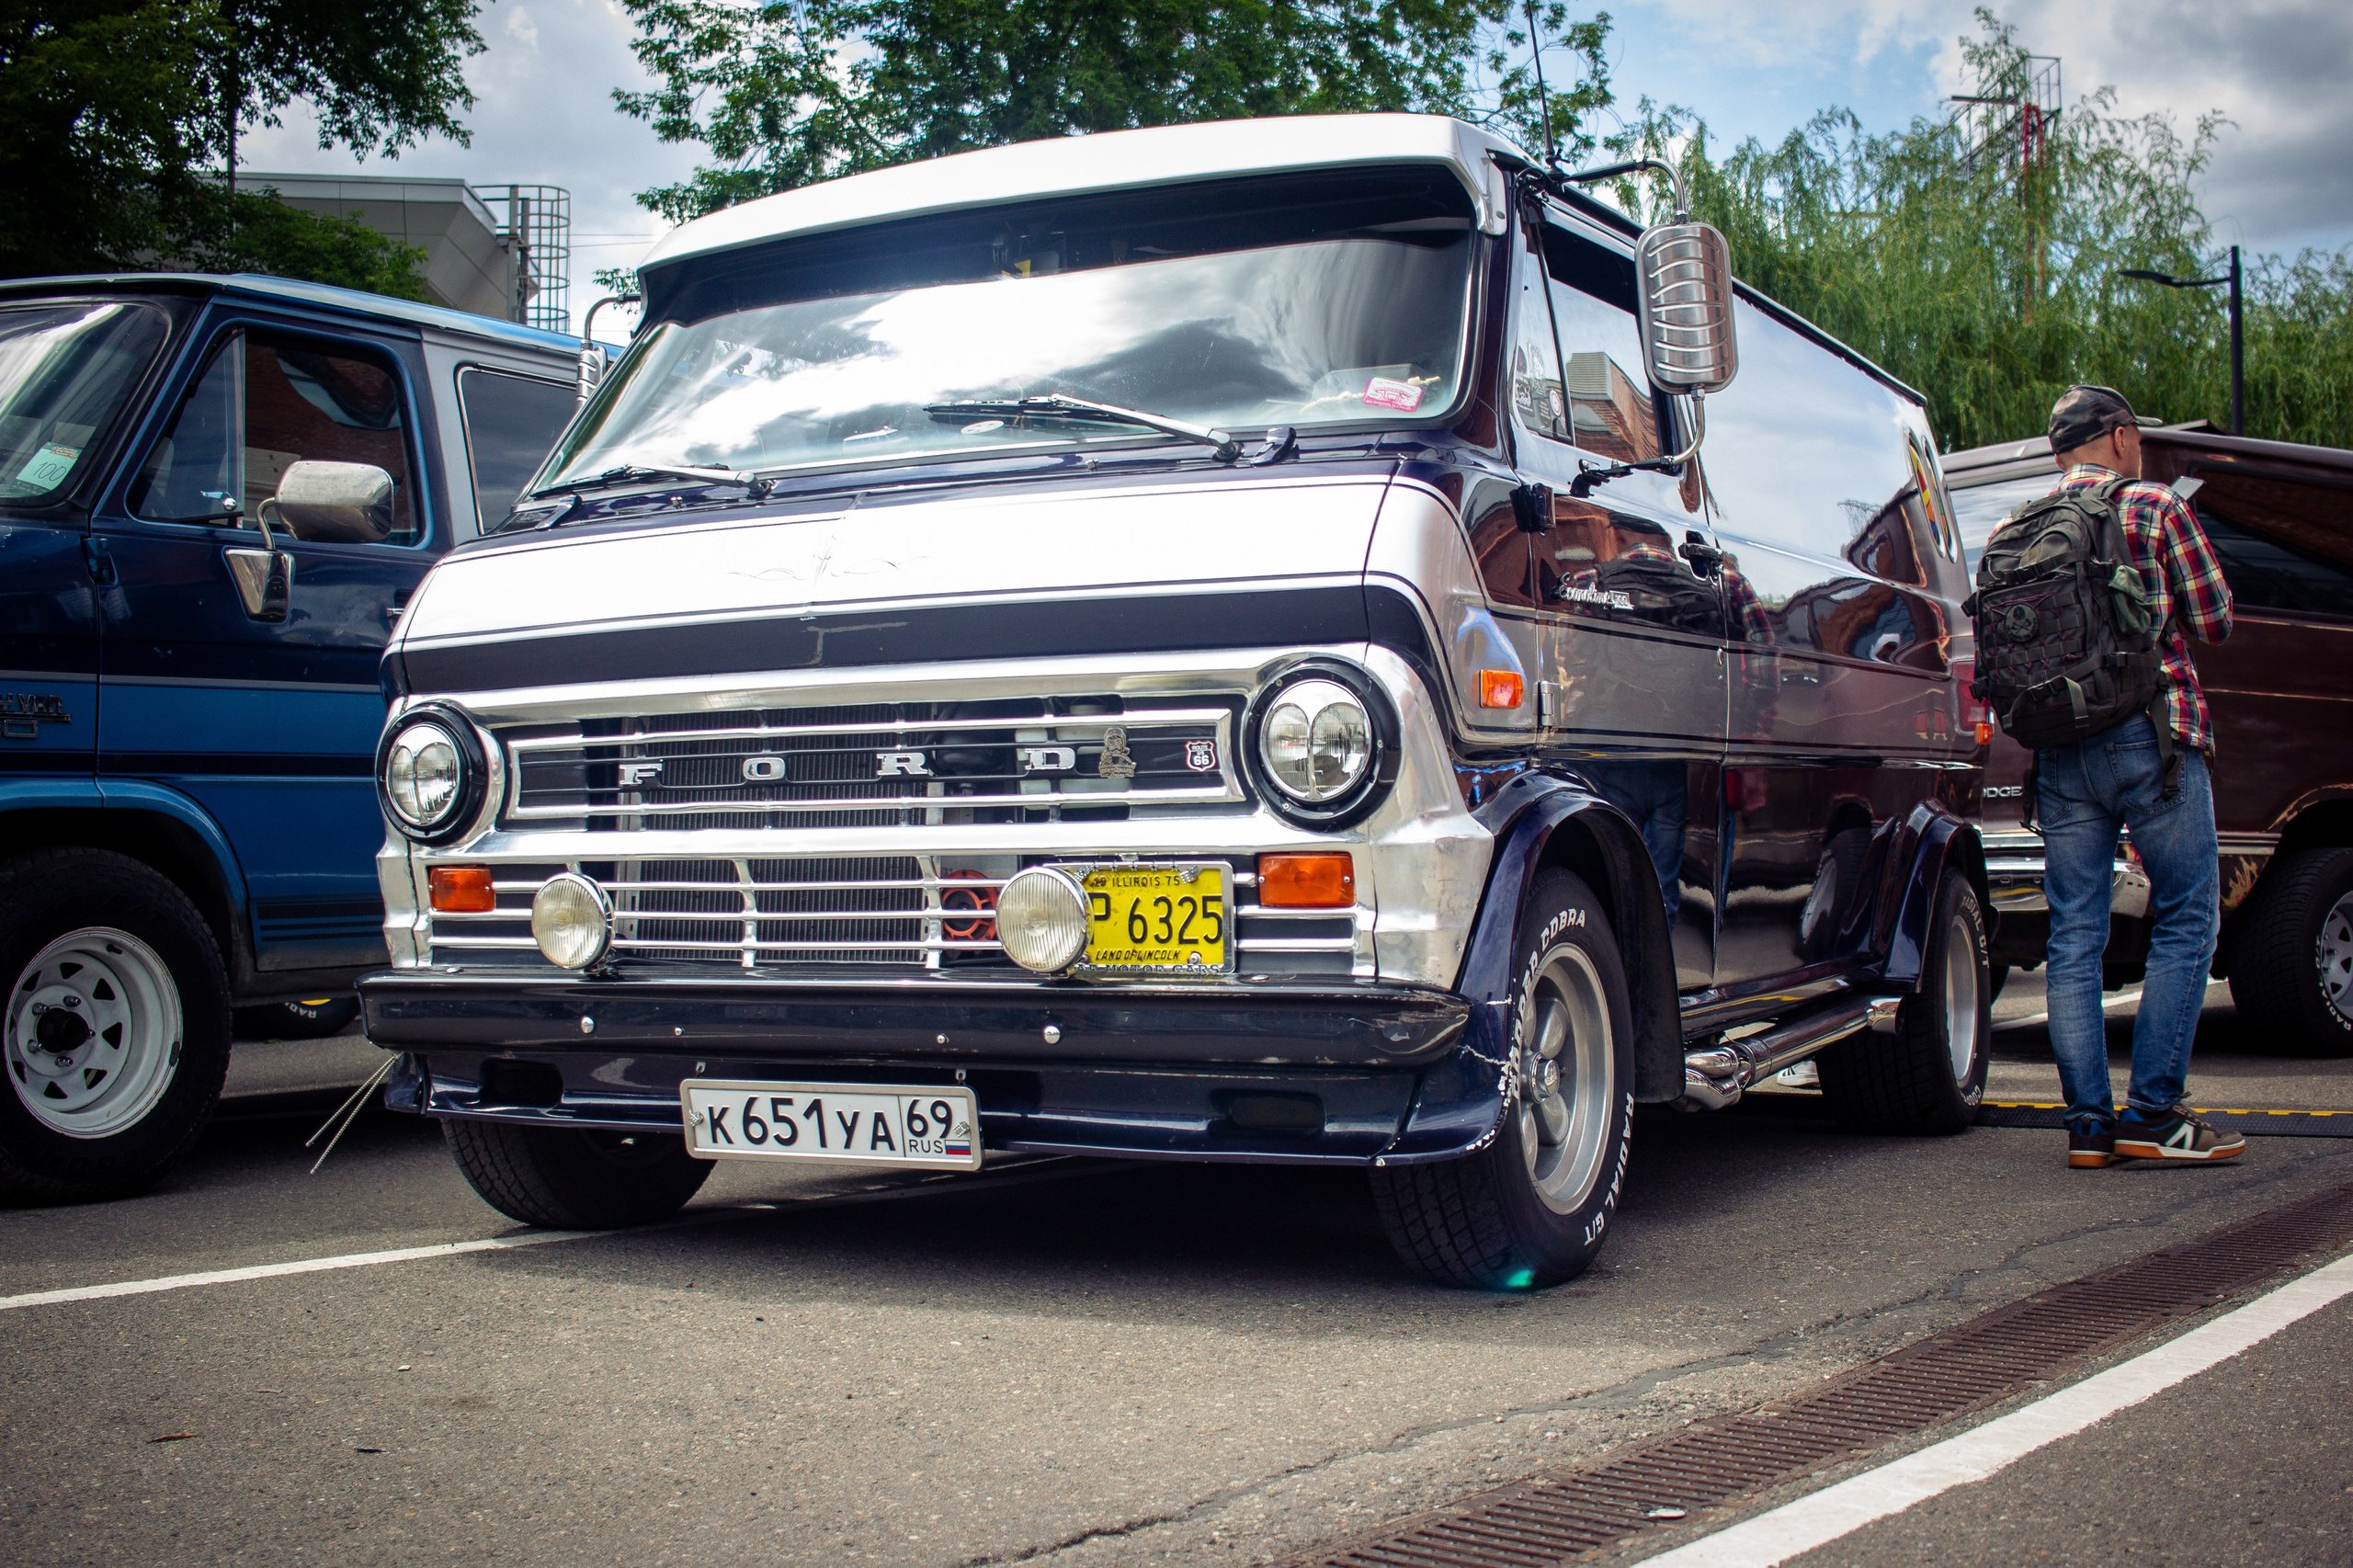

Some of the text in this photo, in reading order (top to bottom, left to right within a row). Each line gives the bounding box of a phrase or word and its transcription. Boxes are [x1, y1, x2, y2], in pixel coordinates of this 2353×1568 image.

[33, 461, 67, 482] 100
[17, 693, 63, 713] VAN
[619, 746, 1076, 787] FORD
[1193, 755, 1210, 766] 66
[1983, 786, 2023, 799] DGE
[1112, 875, 1161, 887] ILLINOIS
[1165, 875, 1181, 887] 75
[1128, 895, 1223, 945] 6325
[1540, 908, 1586, 953] COBRA
[1095, 949, 1181, 962] LAND OF LINCOLN
[1105, 963, 1165, 972] MOTOR
[1173, 964, 1221, 973] CARS
[906, 1098, 952, 1139] 69
[908, 1138, 944, 1154] RUS
[1584, 1092, 1634, 1246] RADIAL G/T
